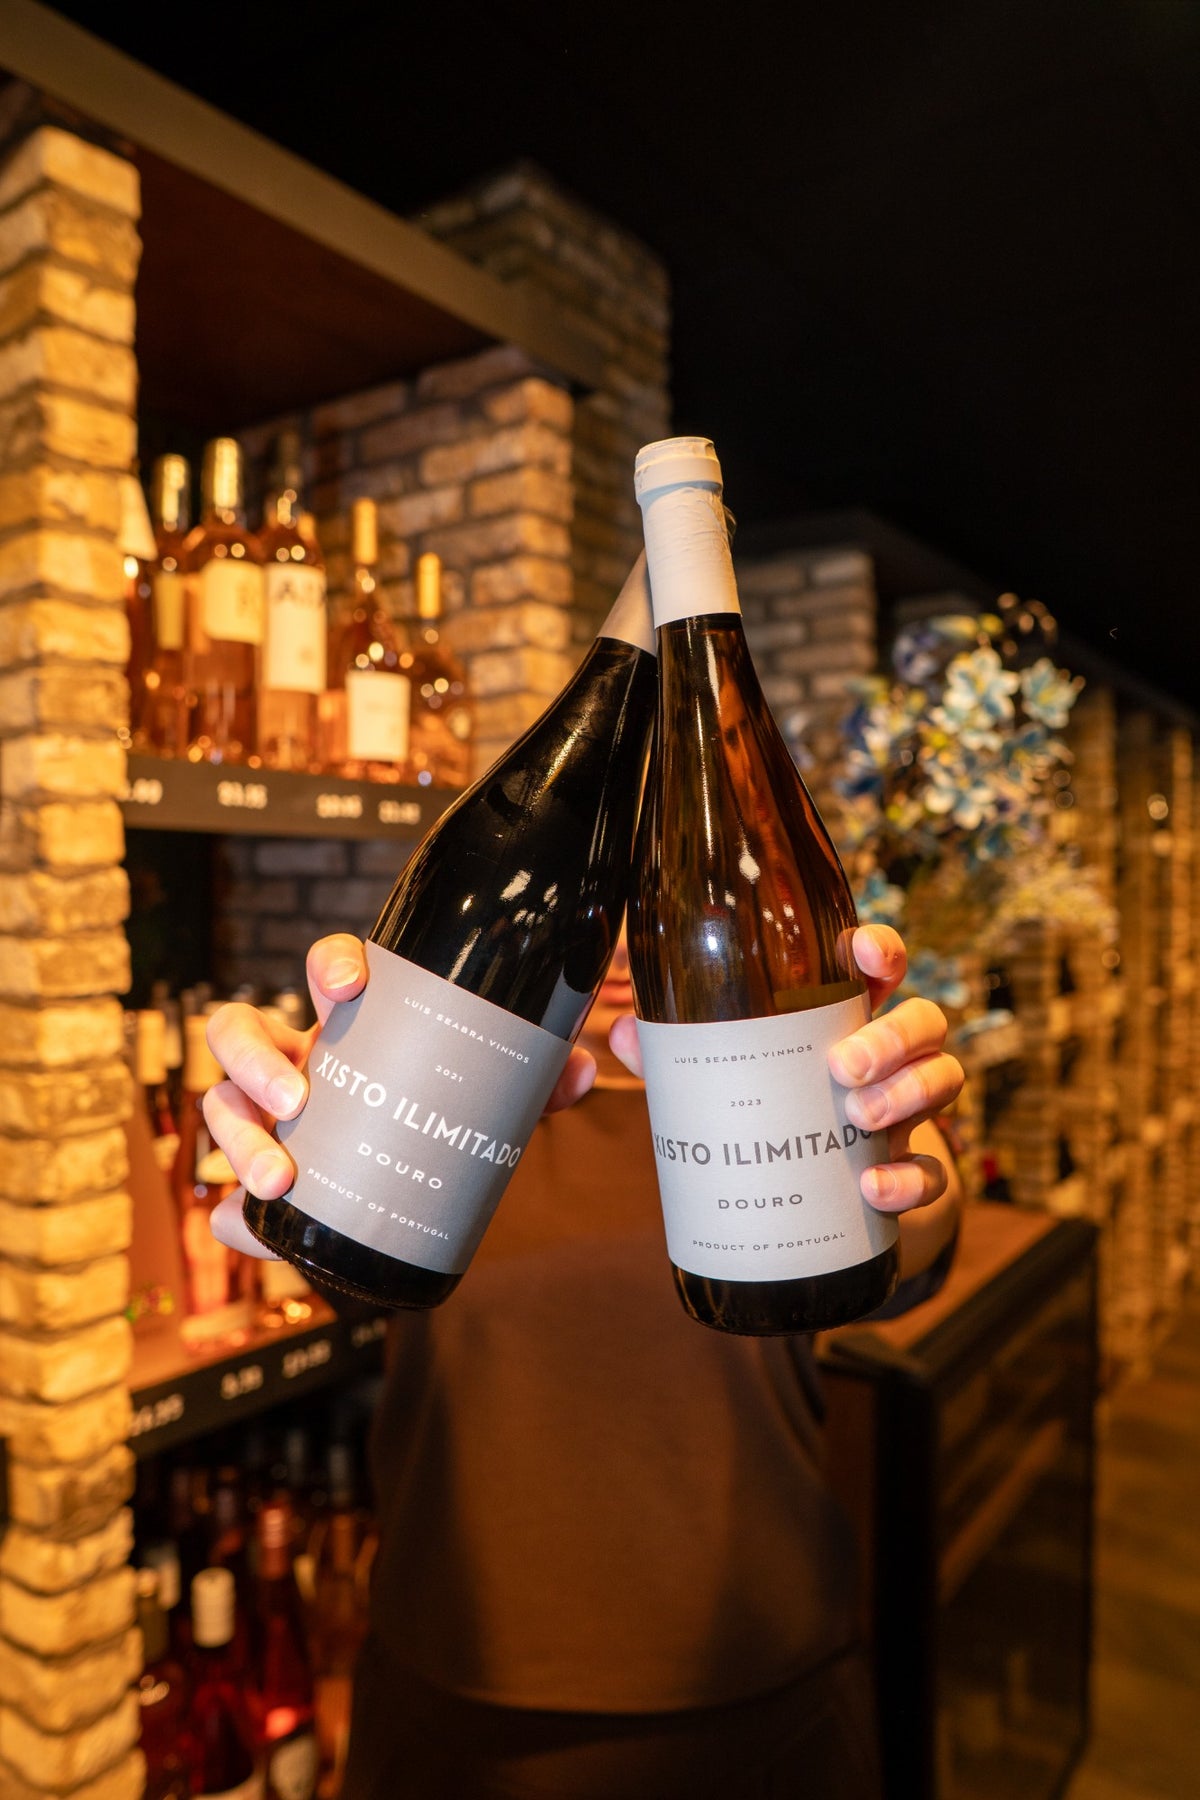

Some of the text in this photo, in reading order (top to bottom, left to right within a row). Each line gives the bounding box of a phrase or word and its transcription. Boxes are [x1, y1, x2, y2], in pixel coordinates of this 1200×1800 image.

[404, 996, 530, 1064] LUIS SEABRA VINHOS
[674, 1043, 814, 1064] LUIS SEABRA VINHOS
[435, 1064, 464, 1082] 2021
[316, 1051, 521, 1168] XISTO ILIMITADO
[730, 1098, 763, 1108] 2023
[654, 1133, 711, 1166] XISTO
[357, 1142, 443, 1190] DOURO
[307, 1167, 450, 1241] PRODUCT OF PORTUGAL
[718, 1193, 804, 1210] DOURO
[692, 1231, 847, 1251] PRODUCT OF PORTUGAL
